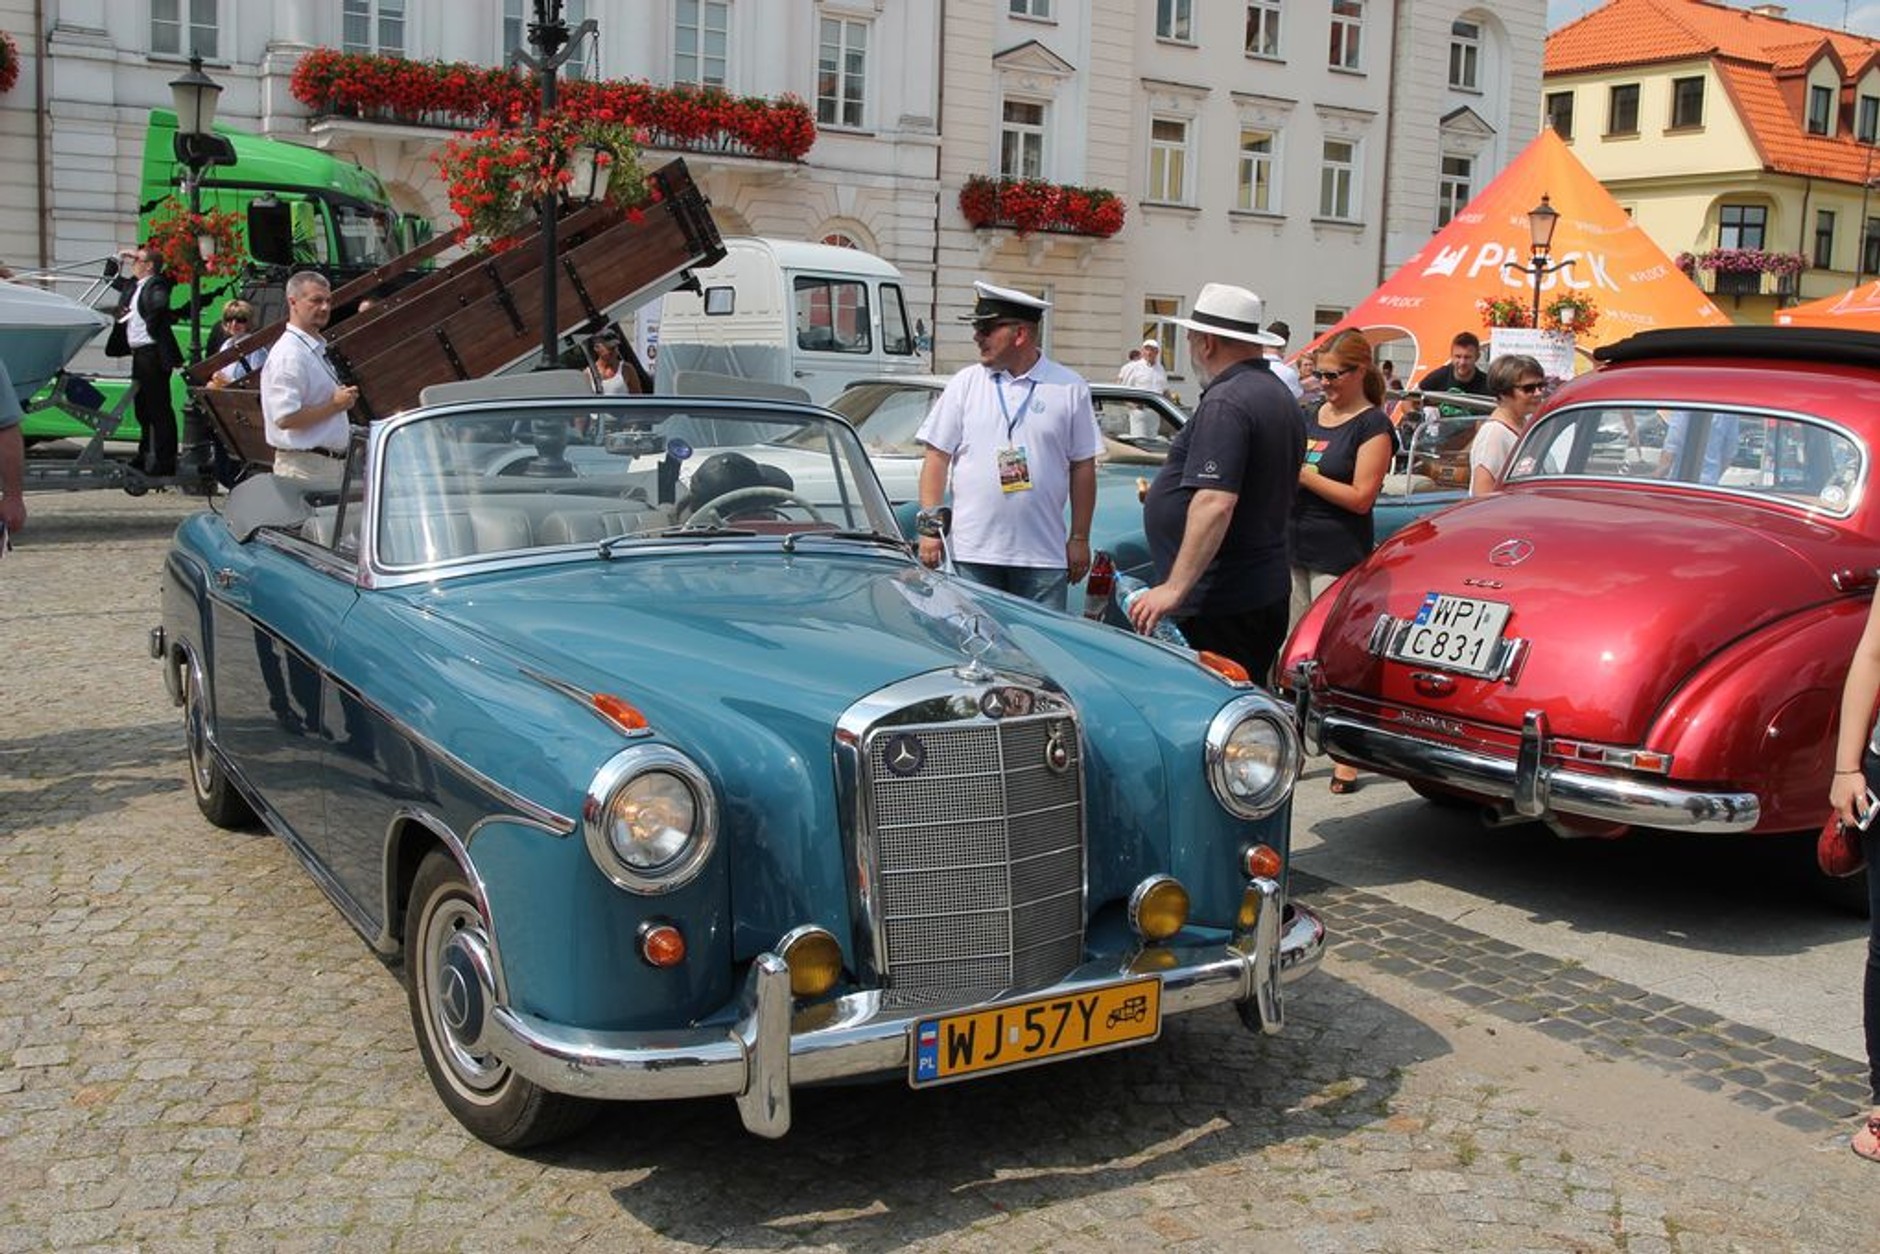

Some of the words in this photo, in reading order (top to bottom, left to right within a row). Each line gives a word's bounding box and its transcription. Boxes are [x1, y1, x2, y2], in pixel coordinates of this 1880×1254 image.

[1433, 598, 1487, 631] WPI
[1411, 629, 1485, 665] C831
[947, 1014, 1003, 1069] WJ
[1023, 996, 1100, 1053] 57Y
[919, 1056, 936, 1071] PL
